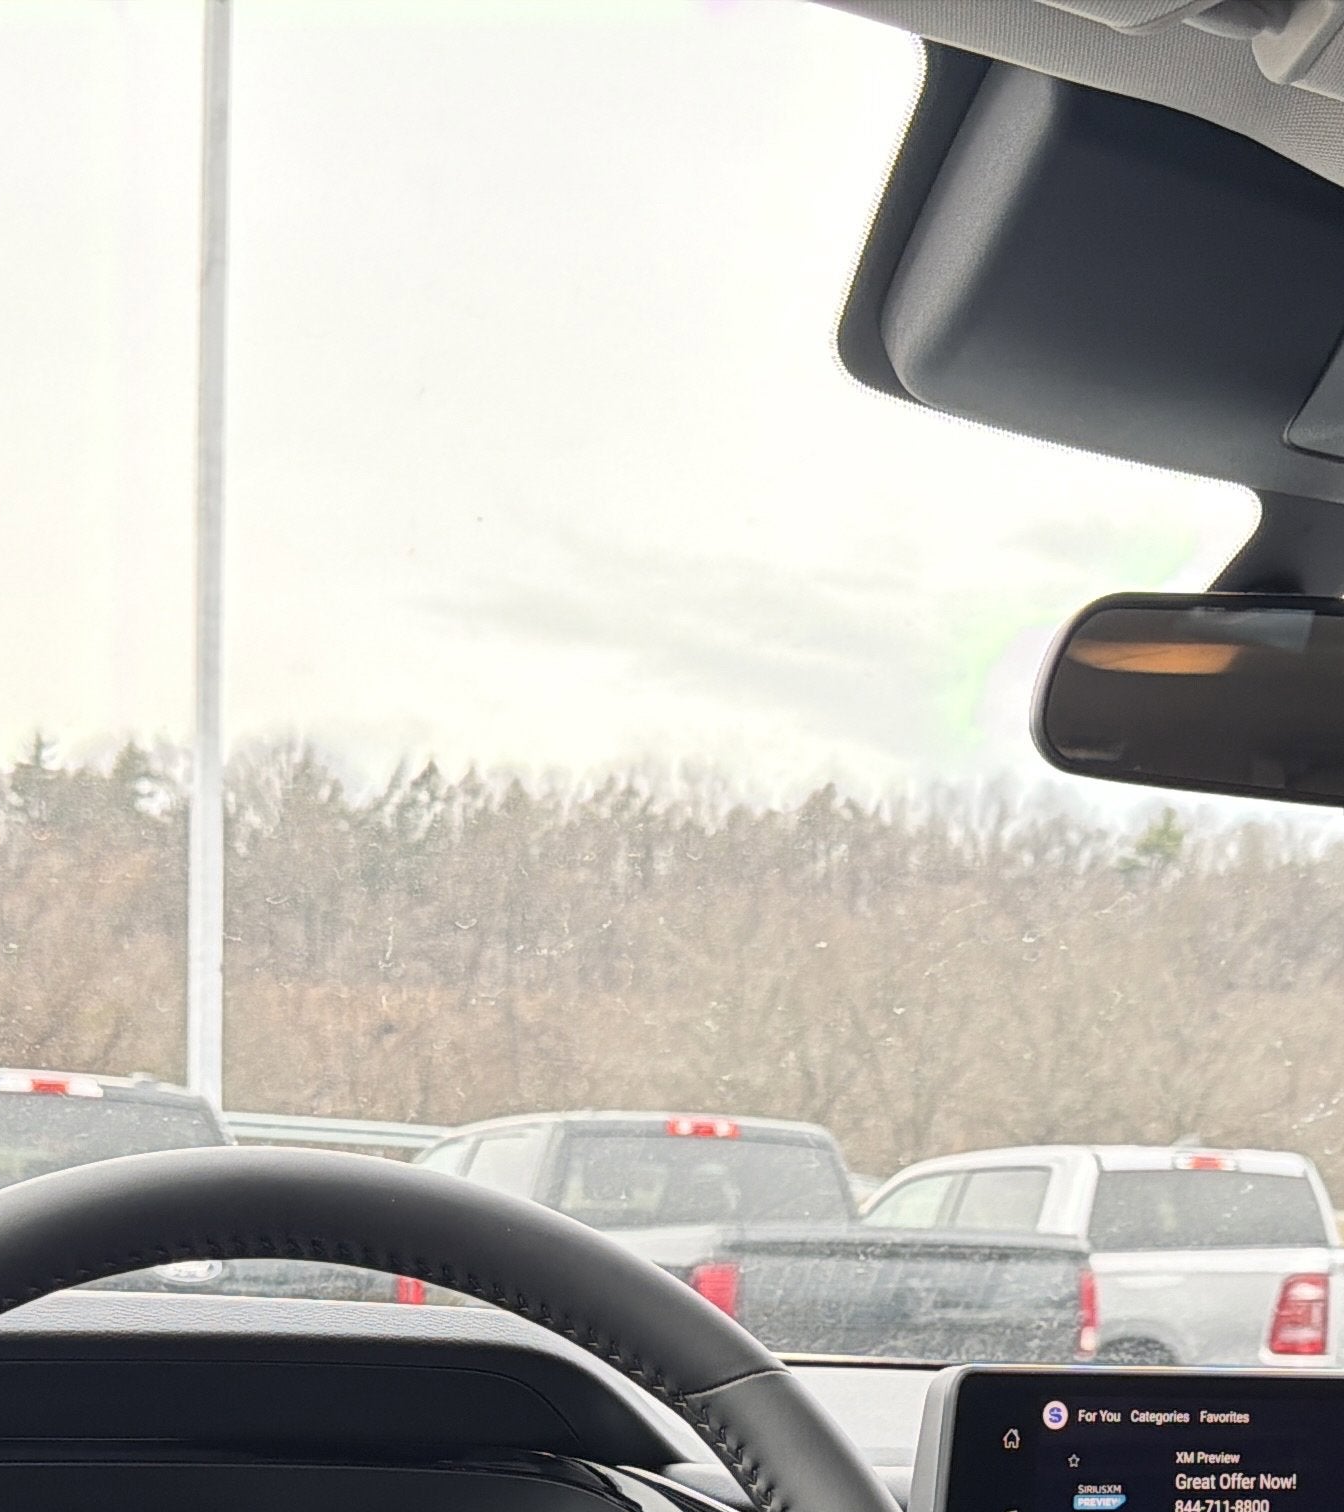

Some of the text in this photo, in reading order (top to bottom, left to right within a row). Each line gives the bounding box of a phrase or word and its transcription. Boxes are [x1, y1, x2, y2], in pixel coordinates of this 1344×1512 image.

[1077, 1409, 1121, 1423] For You
[1130, 1409, 1190, 1426] Categories
[1199, 1410, 1250, 1424] Favorites
[1175, 1452, 1240, 1464] XM Preview
[1175, 1473, 1297, 1490] Great Offer Now!
[1077, 1497, 1121, 1507] PREVIEW
